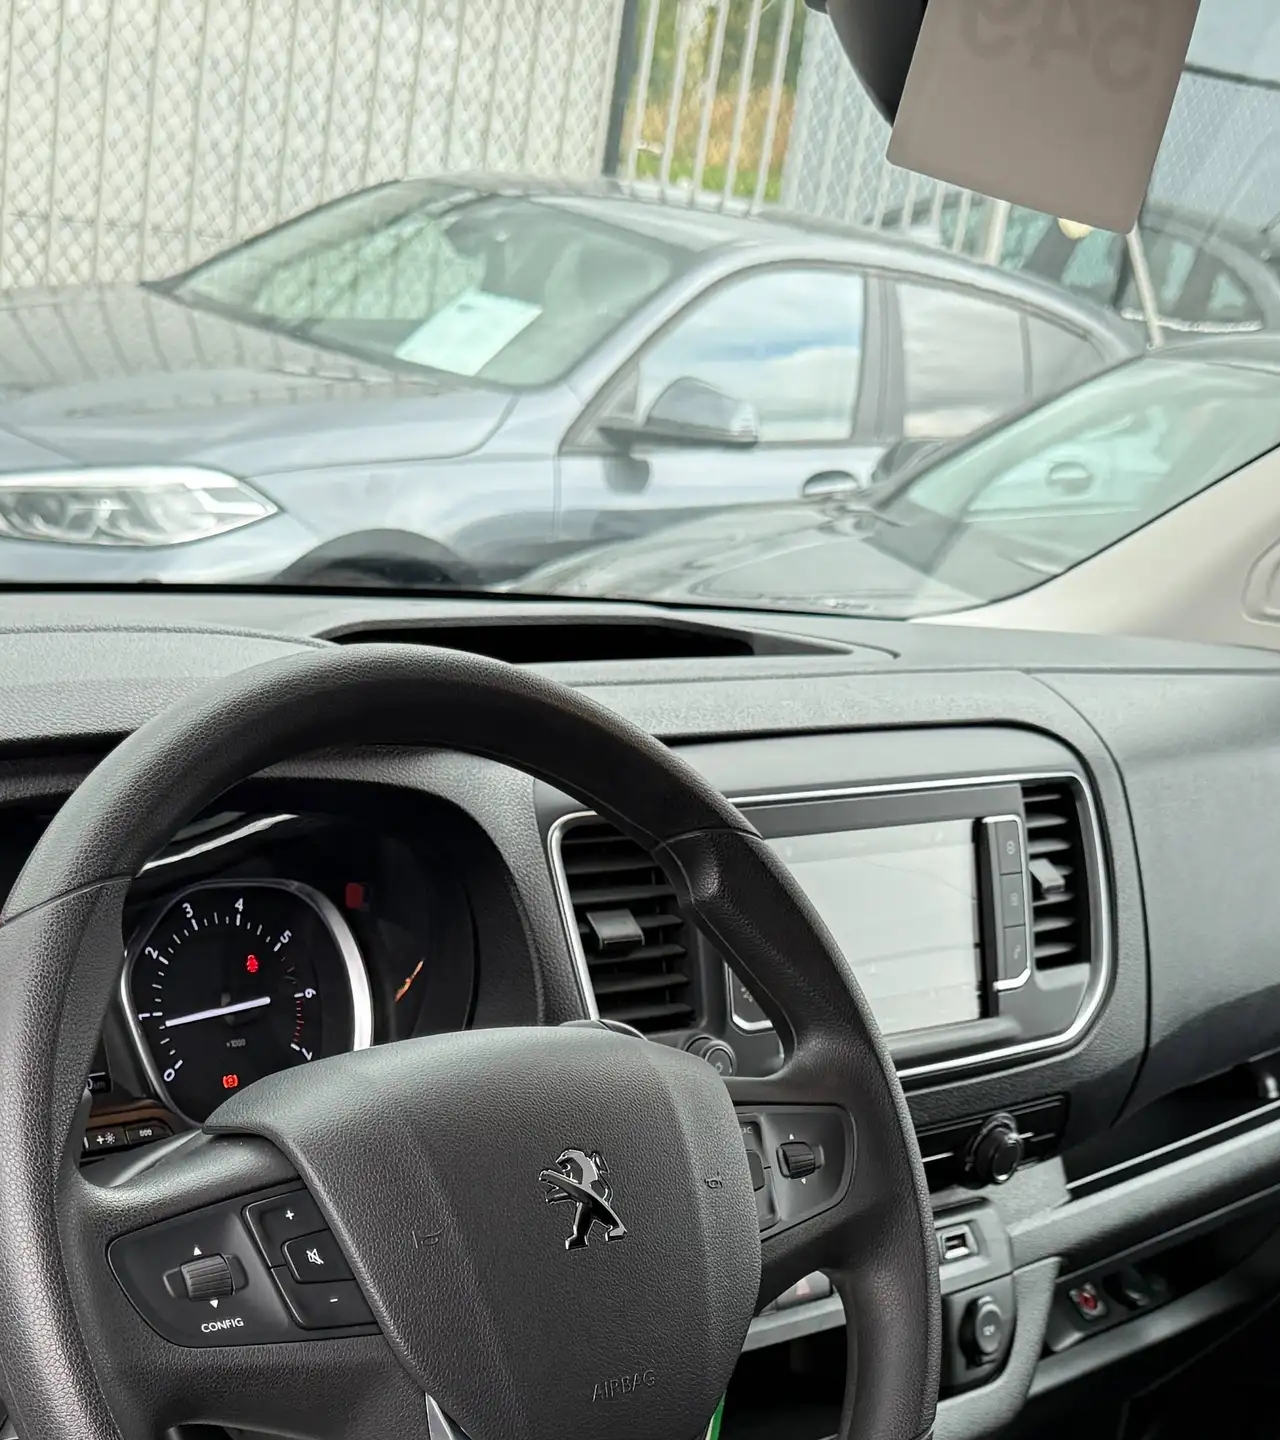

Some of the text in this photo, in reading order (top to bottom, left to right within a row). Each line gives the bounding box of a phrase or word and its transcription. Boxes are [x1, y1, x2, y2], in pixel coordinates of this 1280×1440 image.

[182, 902, 194, 918] 3
[234, 898, 244, 912] 4
[280, 930, 292, 945] 5
[145, 946, 159, 959] 2
[304, 987, 317, 999] 6
[138, 1013, 151, 1021] 1
[301, 1048, 313, 1061] 7
[163, 1069, 176, 1082] 0
[201, 1317, 244, 1333] CONFIG
[592, 1369, 655, 1402] AIRBAG
